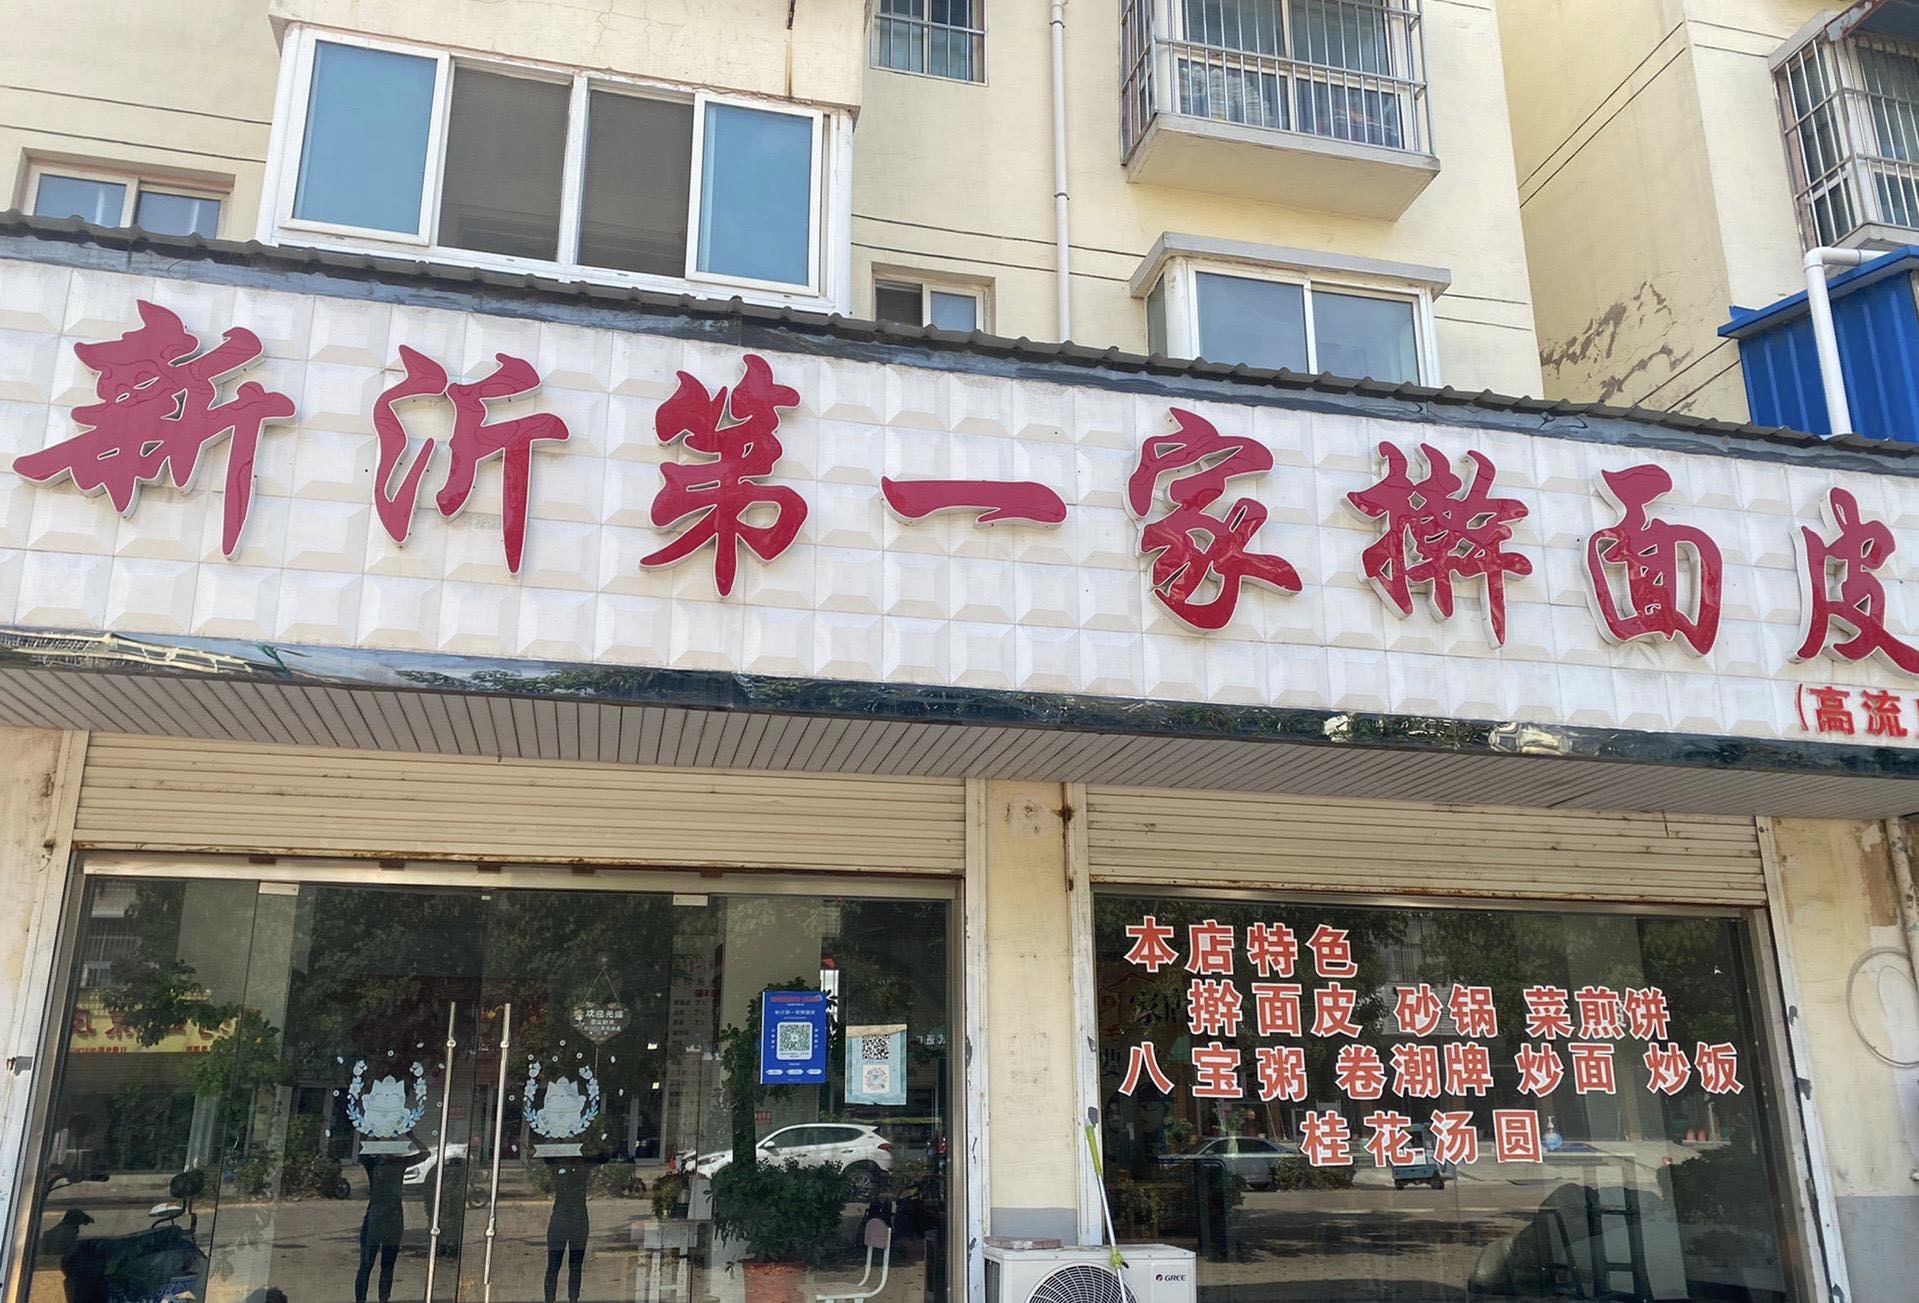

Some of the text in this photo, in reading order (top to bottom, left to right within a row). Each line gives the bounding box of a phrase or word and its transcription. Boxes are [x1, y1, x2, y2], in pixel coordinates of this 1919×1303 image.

[1795, 683, 1919, 739] (高流
[1123, 915, 1358, 978] 本店特色
[1188, 980, 1362, 1038] 擀面皮
[1394, 984, 1499, 1039] 砂锅
[1524, 986, 1671, 1041] 菜煎饼
[1119, 1041, 1308, 1102] 八宝粥
[1335, 1042, 1493, 1100] 卷潮牌
[1515, 1042, 1615, 1096] 炒面
[1645, 1042, 1745, 1096] 炒饭
[1299, 1108, 1543, 1168] 桂花汤圆
[1164, 1274, 1186, 1282] GREE
